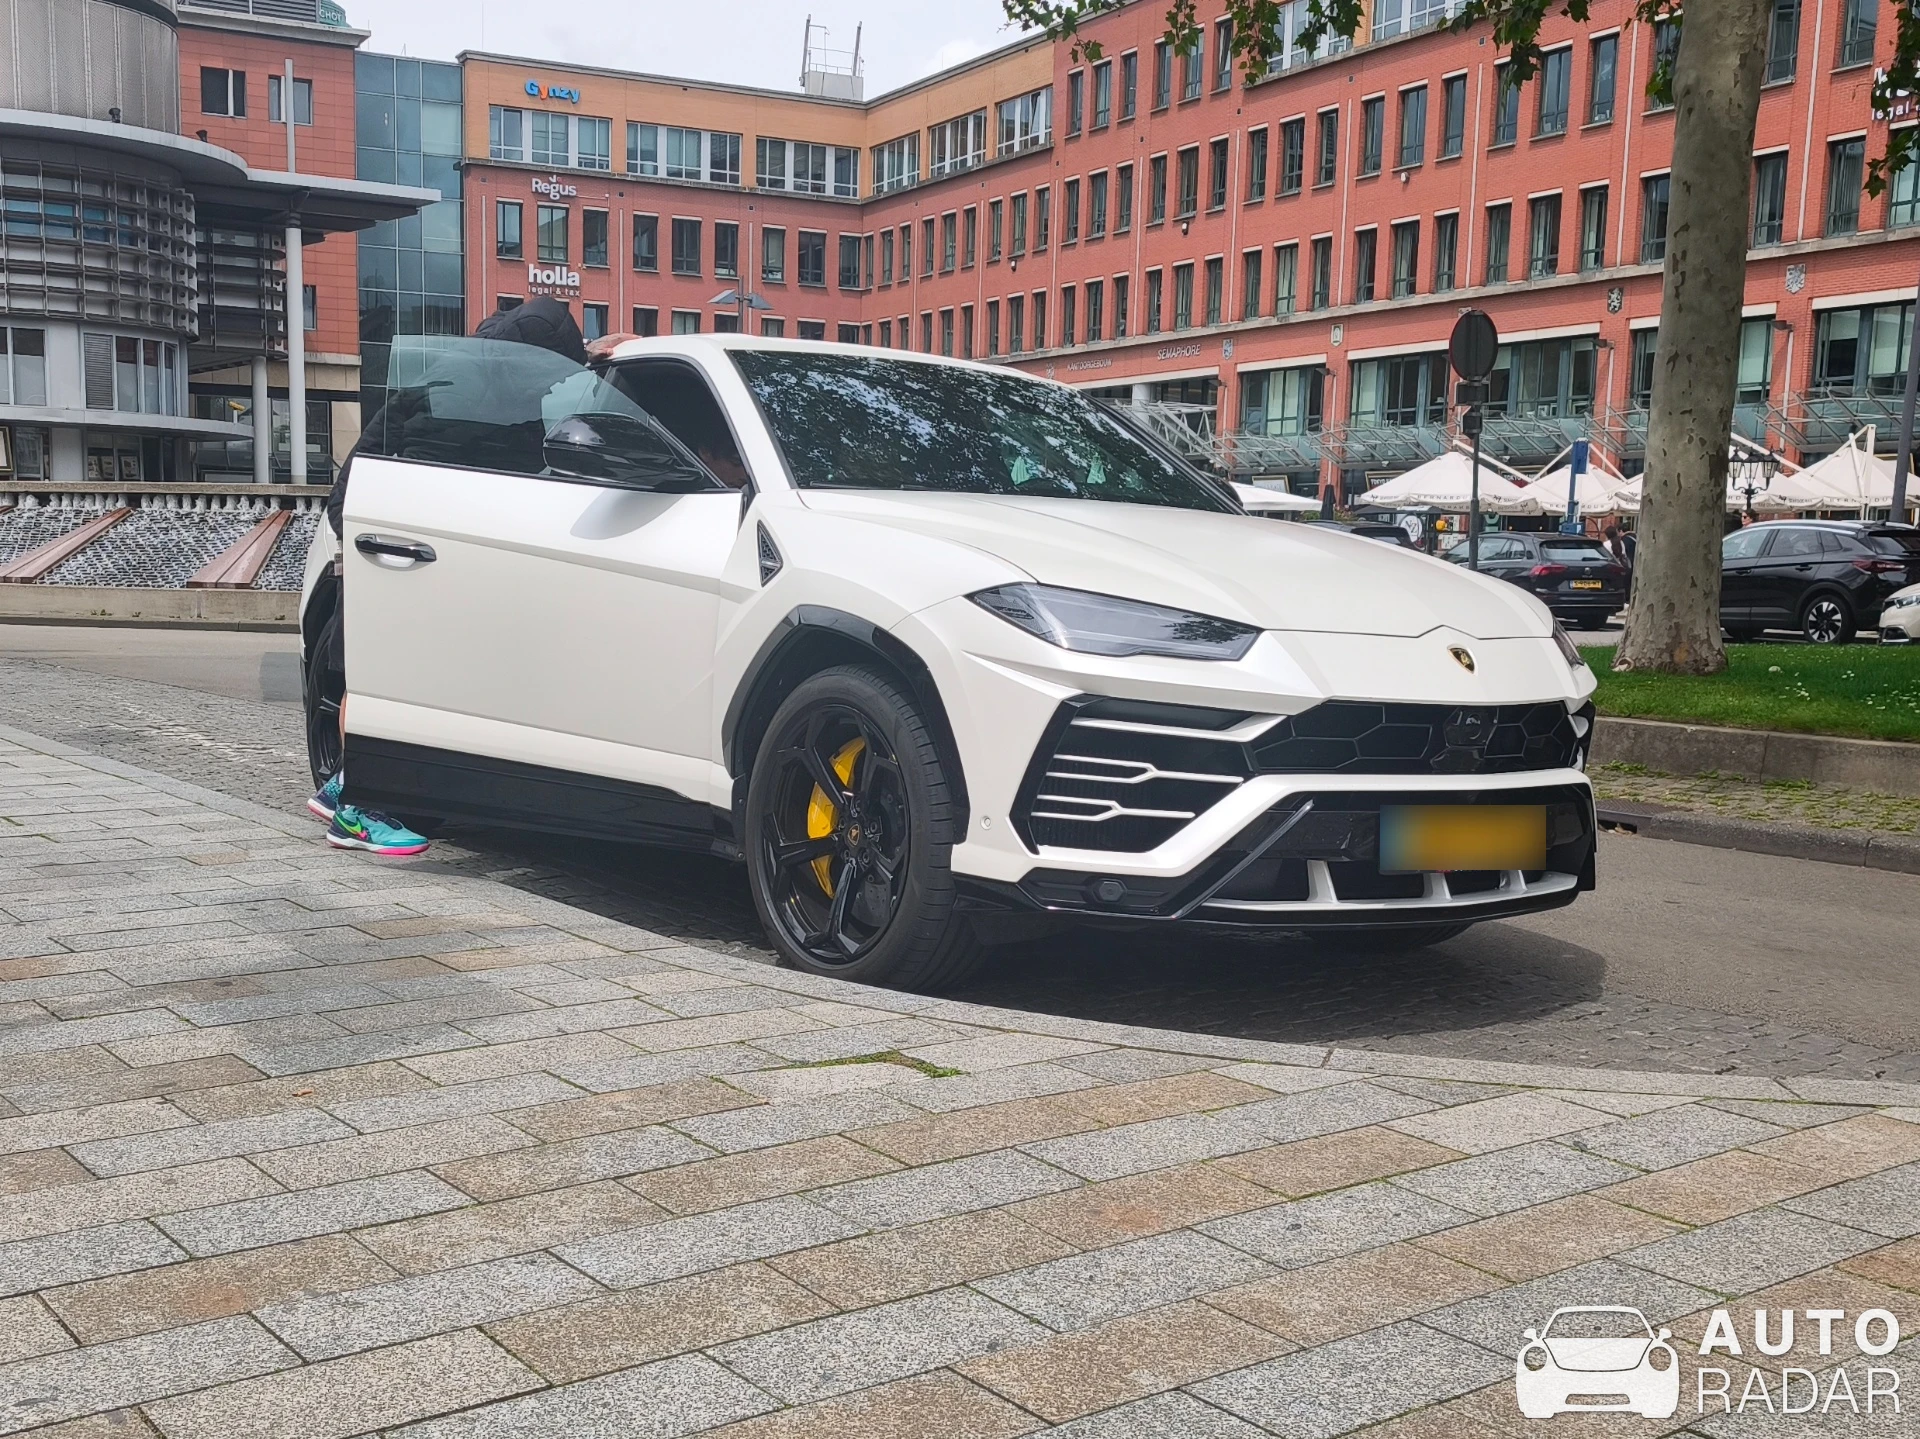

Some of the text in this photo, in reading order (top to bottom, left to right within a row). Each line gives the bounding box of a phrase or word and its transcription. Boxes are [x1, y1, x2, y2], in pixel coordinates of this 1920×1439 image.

[524, 80, 580, 104] Gynzy
[531, 177, 577, 200] Regus
[528, 263, 580, 286] holla
[528, 285, 580, 297] legal & tax
[1067, 344, 1201, 371] KANTOORGEBOUW SEMAPHORE
